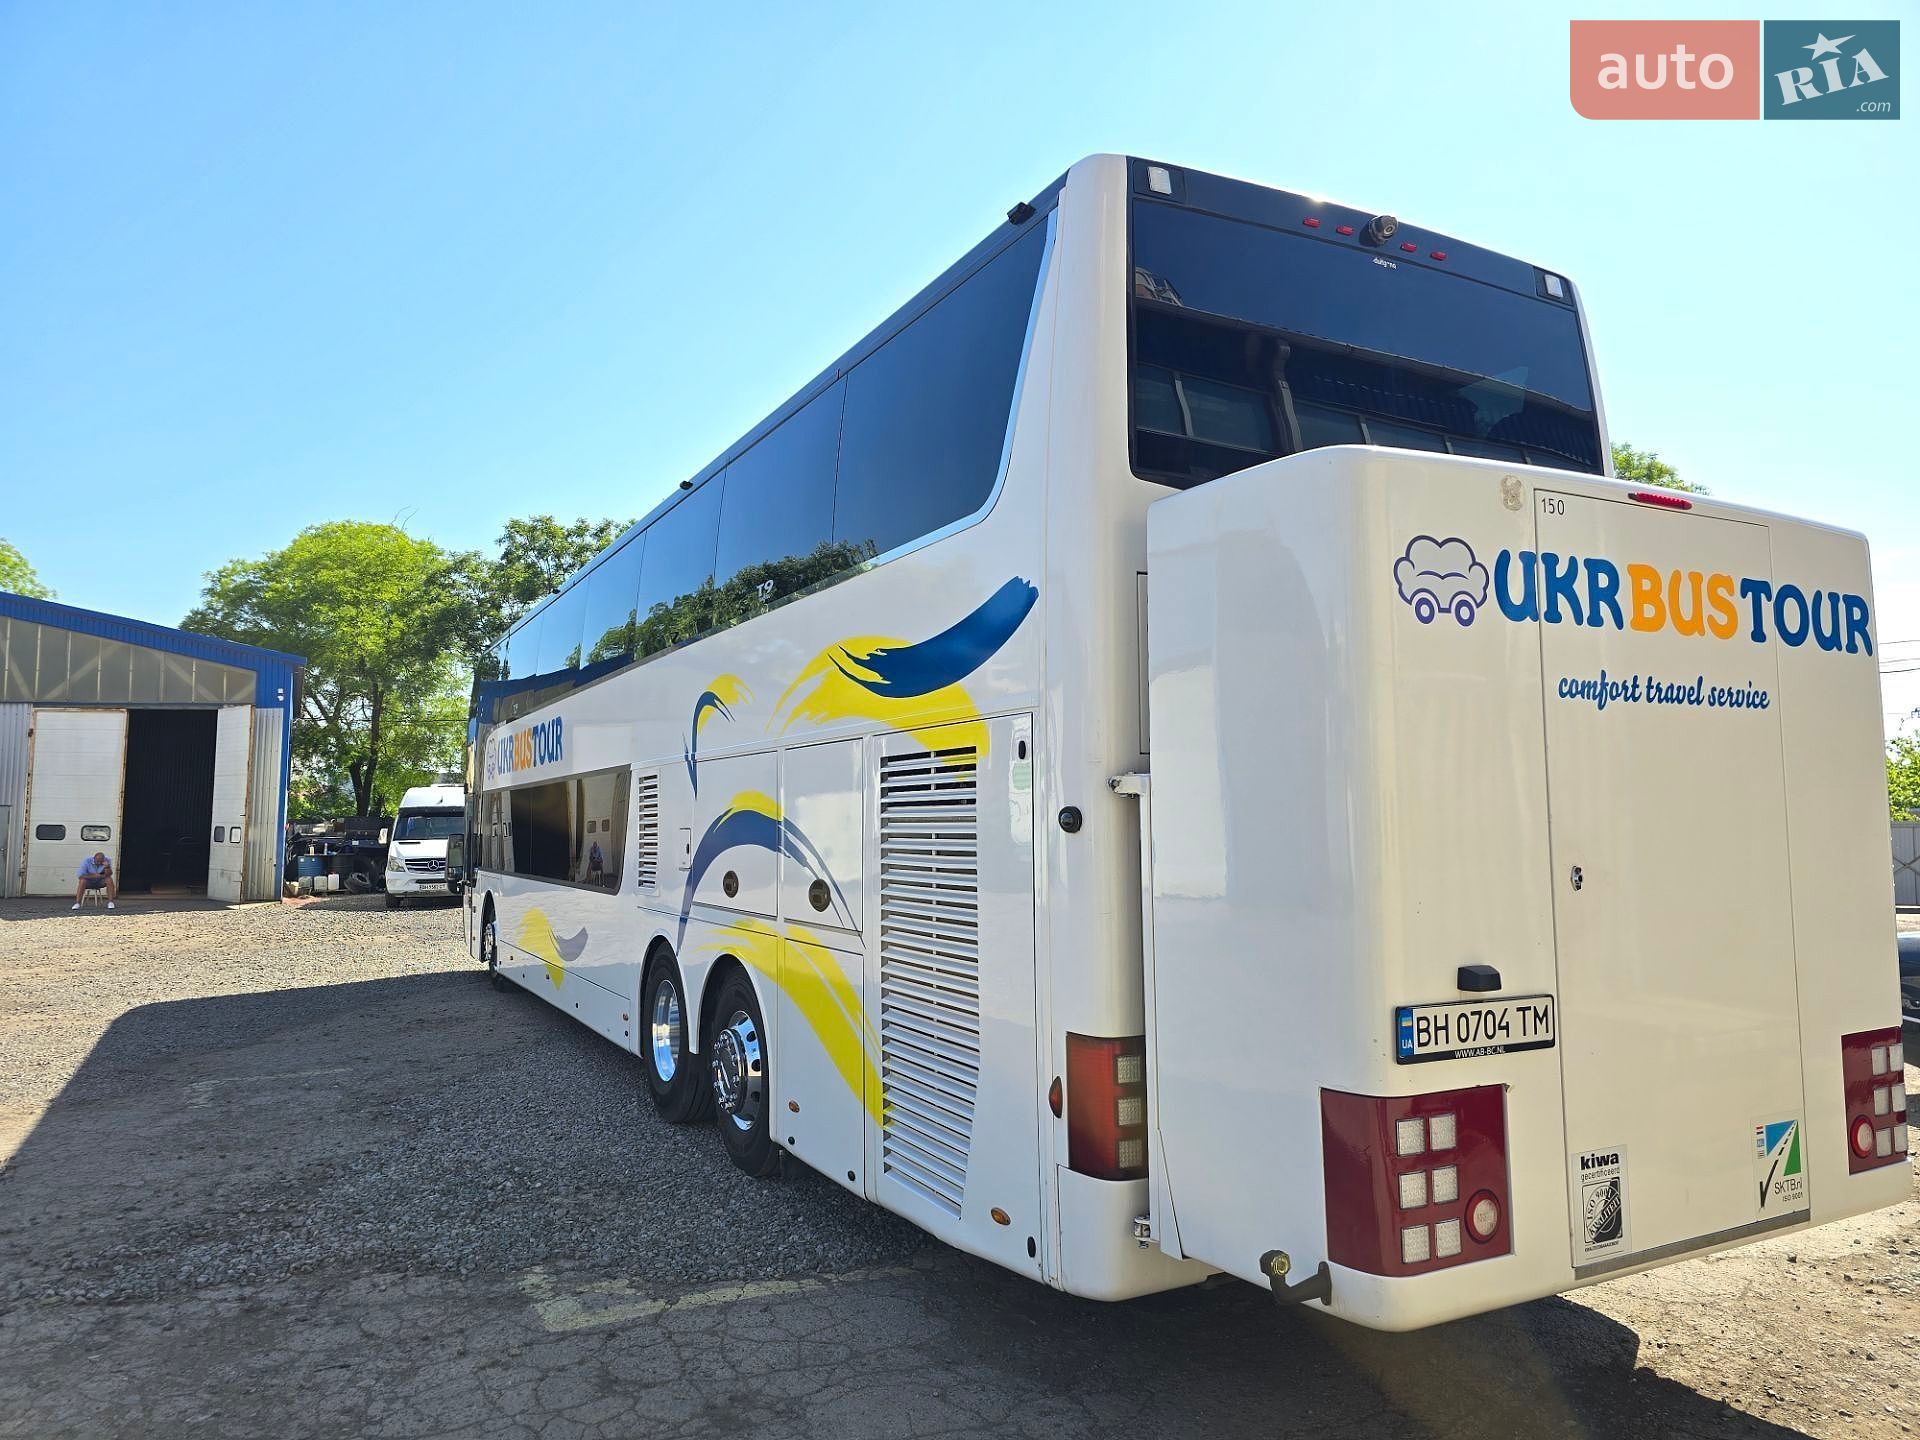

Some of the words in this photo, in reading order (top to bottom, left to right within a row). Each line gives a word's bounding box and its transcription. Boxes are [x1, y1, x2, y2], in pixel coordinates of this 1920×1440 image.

[1541, 497, 1565, 516] 150
[1558, 669, 1642, 711] comfort
[1646, 675, 1705, 706] travel
[1708, 680, 1771, 710] service
[1416, 1013, 1450, 1048] BH
[1456, 1007, 1510, 1044] 0704
[1516, 1004, 1550, 1037] TM
[1401, 1038, 1413, 1049] UA
[1580, 1153, 1619, 1171] kiwa
